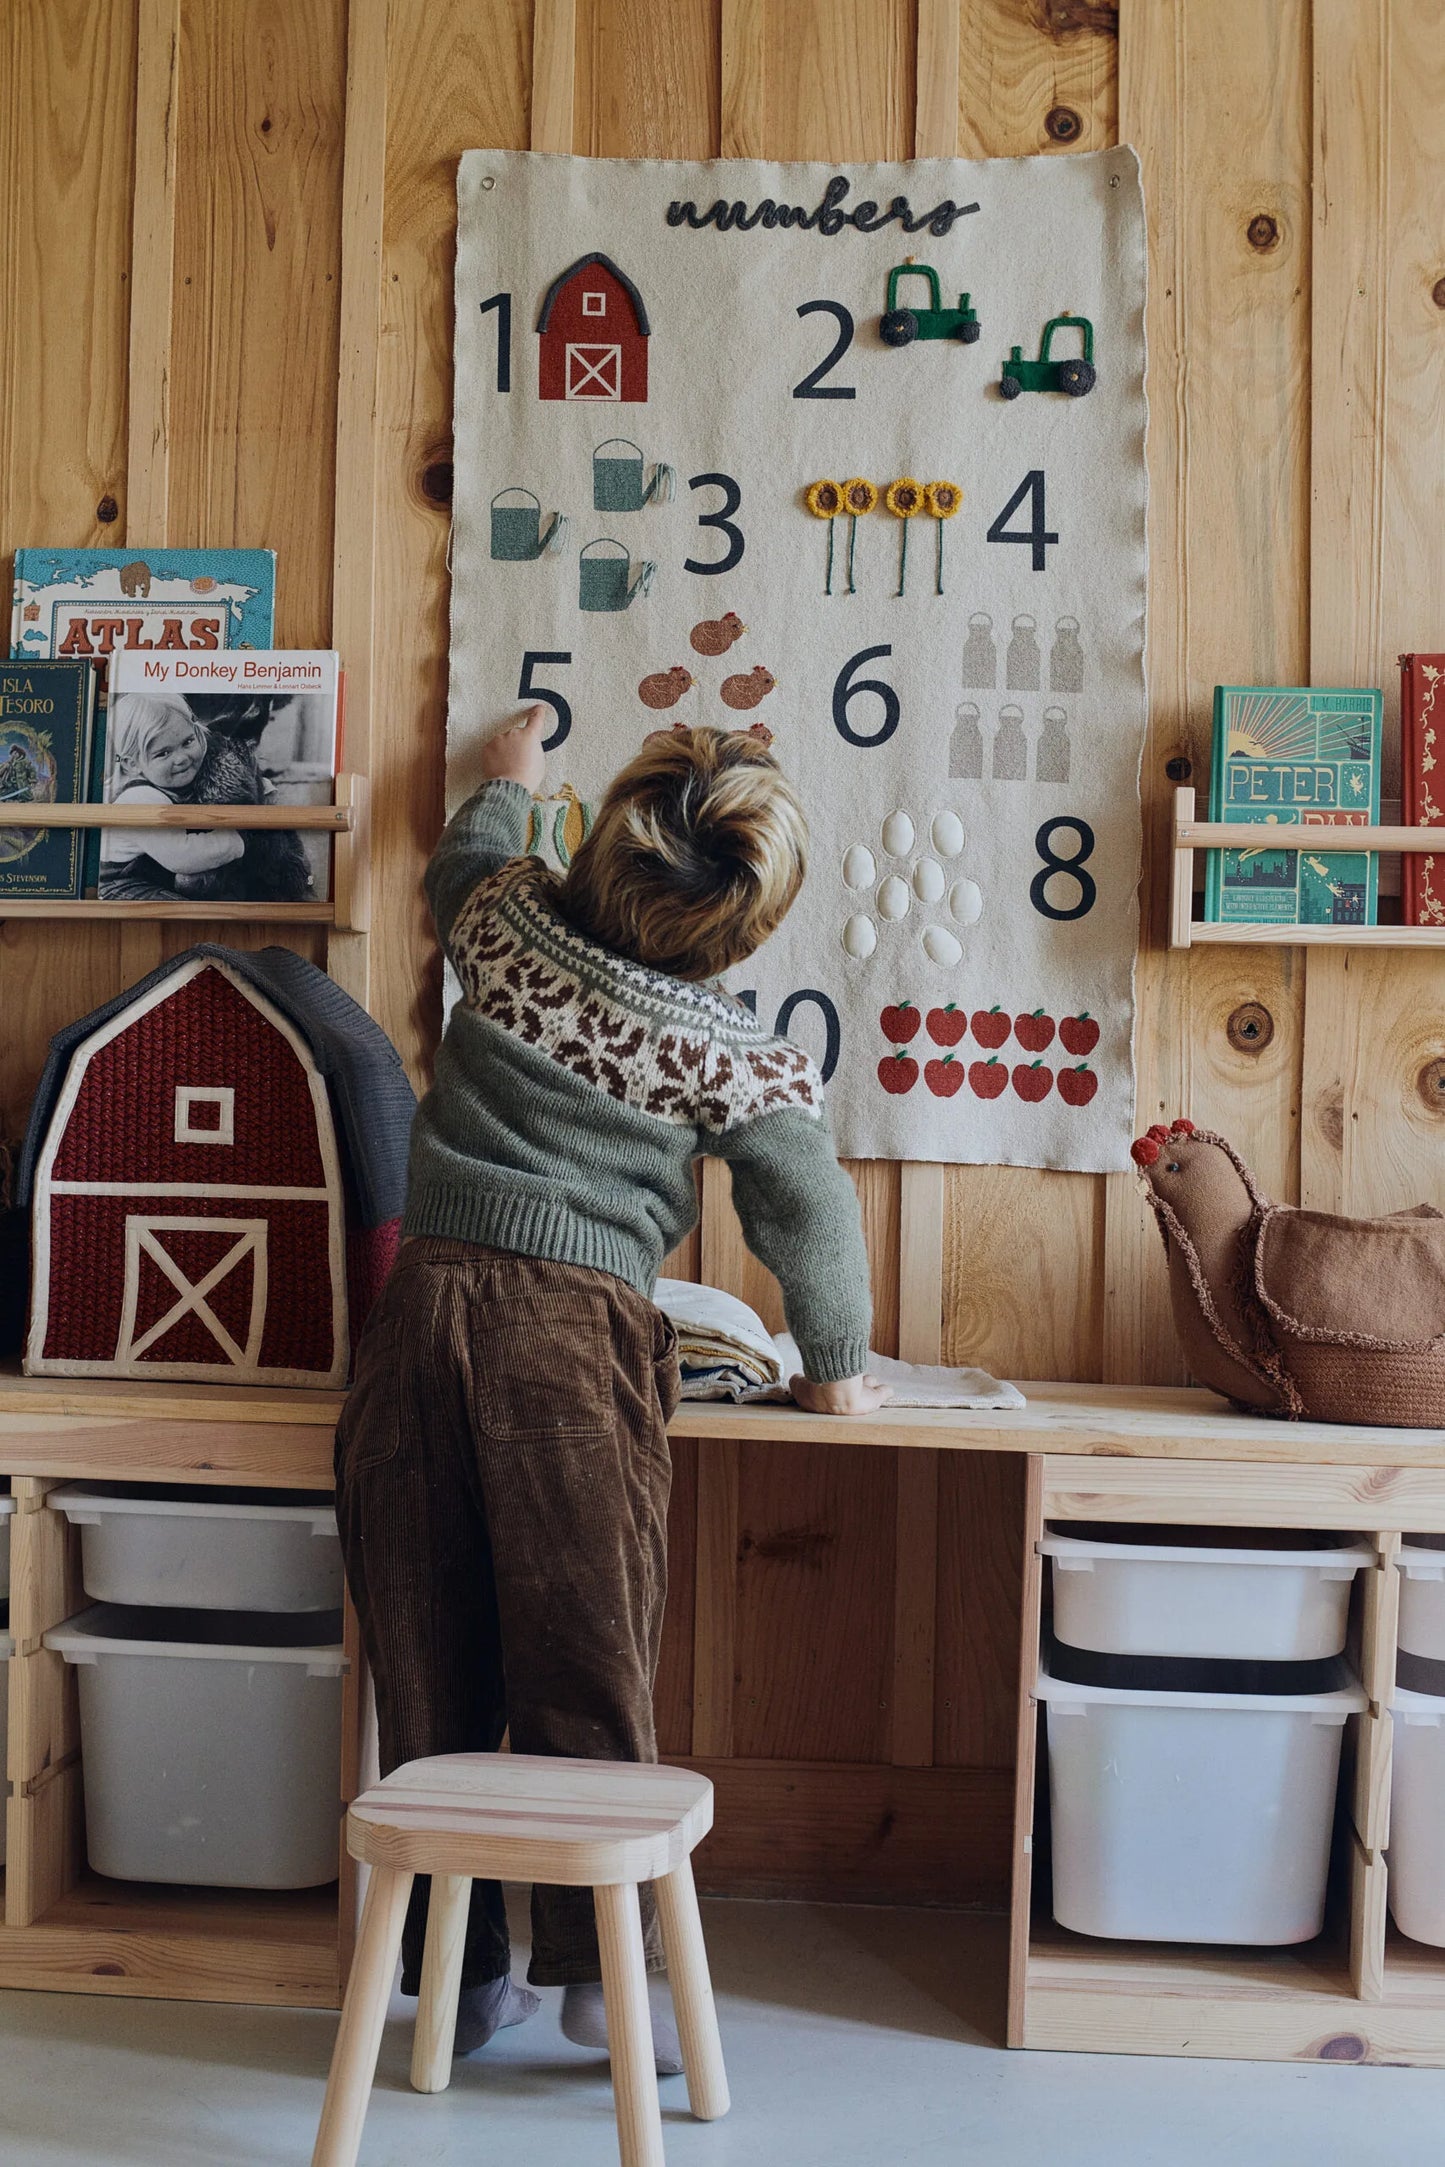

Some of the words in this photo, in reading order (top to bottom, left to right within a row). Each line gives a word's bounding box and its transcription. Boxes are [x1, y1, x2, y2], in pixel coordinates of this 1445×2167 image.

[666, 176, 980, 236] numbers
[479, 293, 512, 393] 1
[792, 300, 857, 399] 2
[683, 473, 745, 575] 3
[986, 469, 1059, 571] 4
[59, 618, 220, 654] ATLAS
[144, 661, 169, 682] My
[175, 661, 238, 682] Donkey
[243, 661, 322, 682] Benjamin
[2, 678, 34, 693] ISLA
[517, 651, 573, 752] 5
[831, 644, 900, 748] 6
[1228, 765, 1335, 802] PETER
[6, 873, 47, 883] STEVENSON
[1029, 816, 1097, 921] 8
[736, 989, 841, 1085] 0
